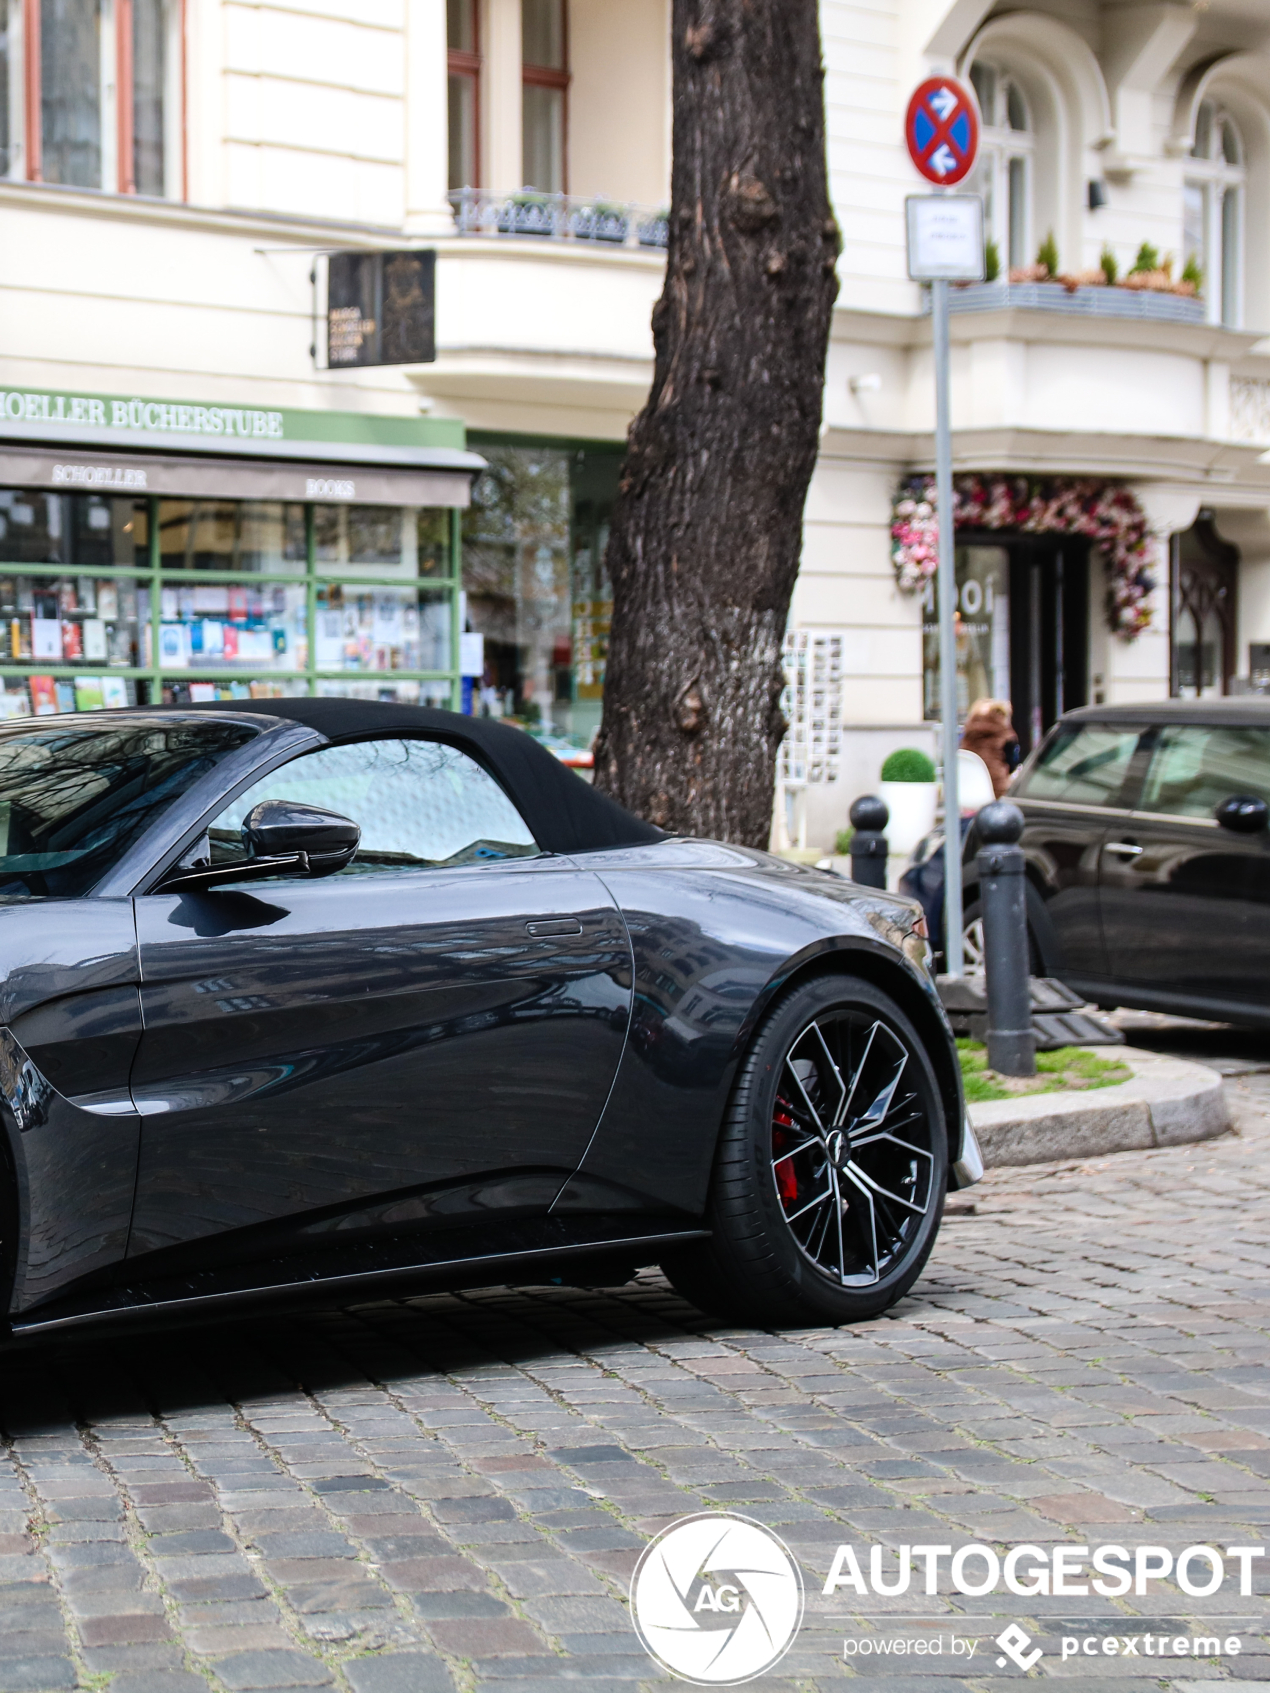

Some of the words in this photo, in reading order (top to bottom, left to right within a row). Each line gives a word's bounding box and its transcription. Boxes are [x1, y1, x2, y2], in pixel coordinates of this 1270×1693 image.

[110, 397, 284, 438] BÜCHERSTUBE
[52, 464, 147, 490] SCHOELLER
[306, 478, 355, 499] BOOKS
